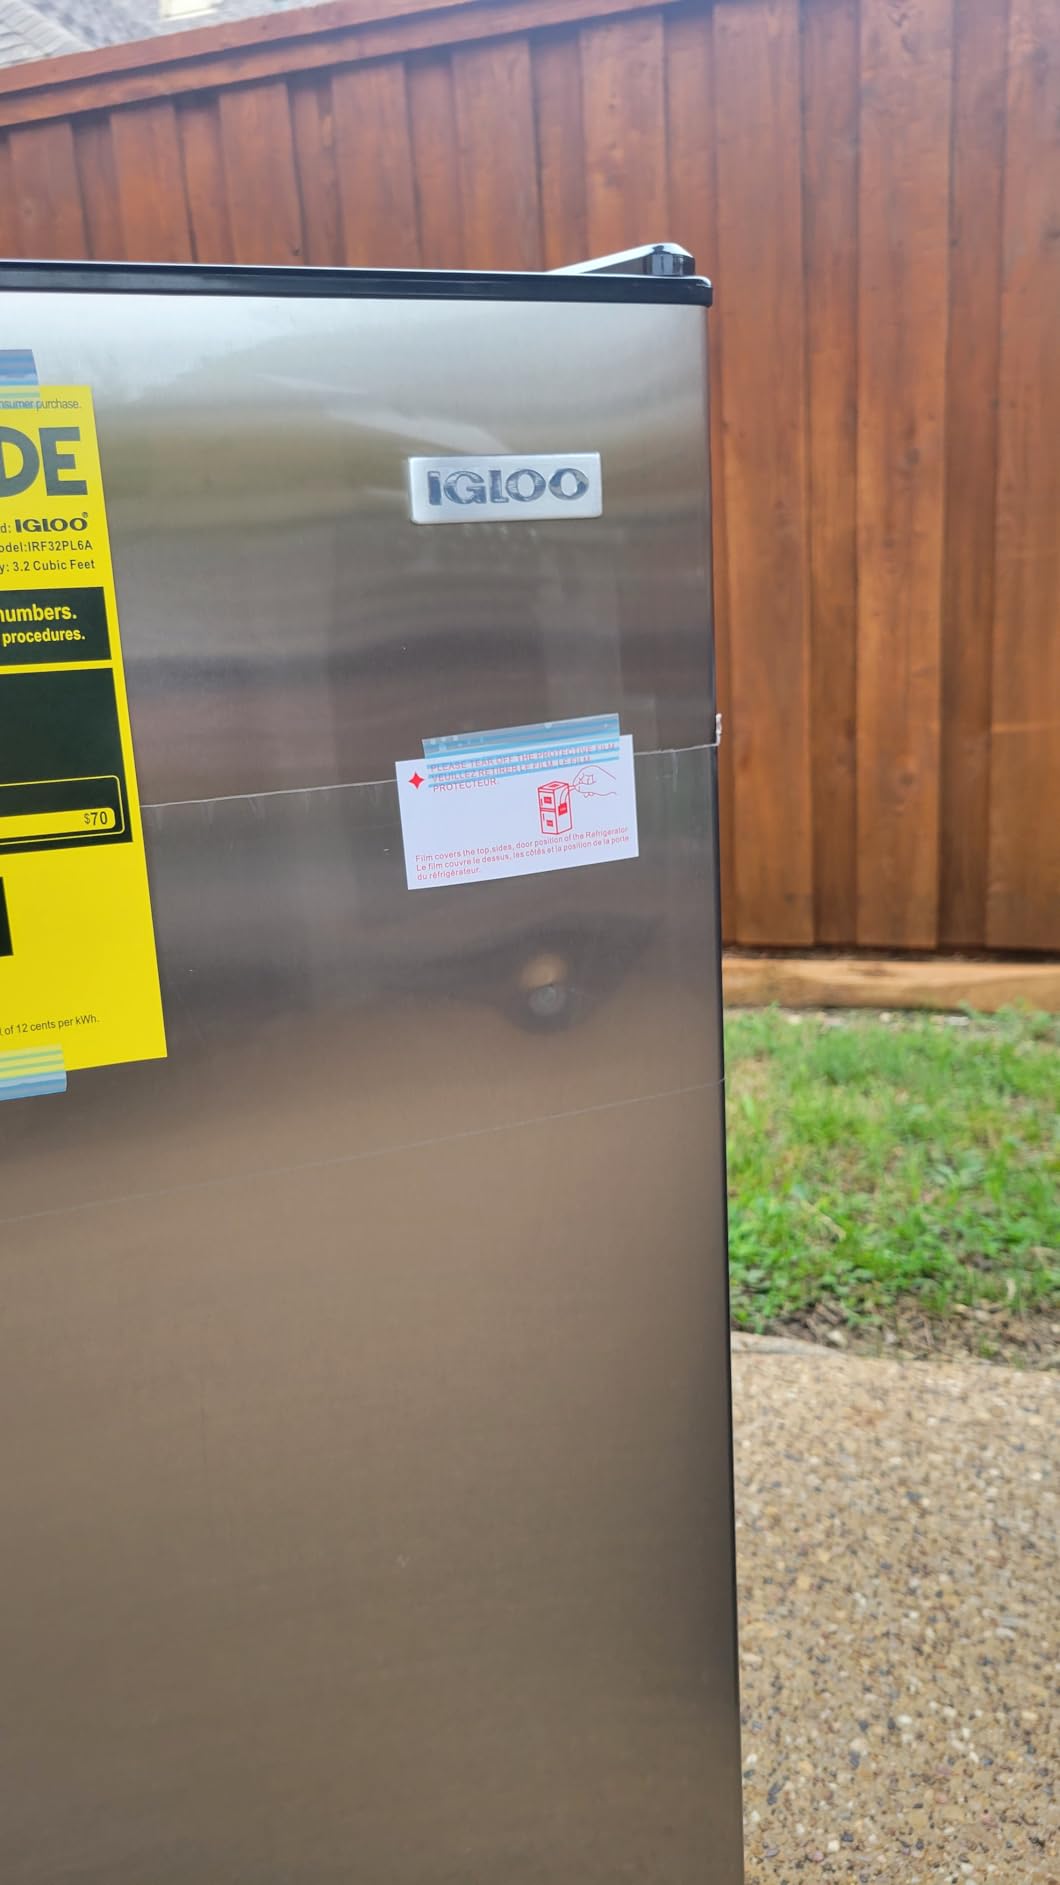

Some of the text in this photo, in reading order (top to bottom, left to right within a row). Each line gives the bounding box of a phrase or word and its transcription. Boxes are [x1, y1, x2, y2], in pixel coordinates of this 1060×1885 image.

[36, 398, 81, 412] purchase.
[0, 426, 88, 498] DE
[427, 467, 590, 506] IGLOO
[13, 561, 30, 571] 3.2
[33, 560, 67, 571] Cubic
[70, 559, 95, 569] Feet
[2, 628, 86, 647] procedures.
[431, 760, 467, 772] PLEASE
[471, 758, 494, 768] TEAR
[496, 756, 513, 765] OFF
[517, 752, 534, 761] THE
[537, 745, 592, 758] PROTECTIVE
[432, 770, 476, 782] VEUILLEZ
[478, 764, 517, 776] RETIRER
[520, 764, 529, 773] LE
[557, 758, 567, 767] LE
[433, 777, 496, 792] PROTECTEUR
[84, 811, 108, 826] $70
[416, 864, 427, 872] Le
[428, 862, 443, 870] film
[445, 859, 472, 868] couvre
[472, 857, 481, 865] le
[481, 853, 512, 864] dessus,
[525, 847, 545, 857] côtés
[546, 846, 554, 854] et
[563, 840, 592, 852] position
[592, 838, 601, 846] de
[603, 837, 610, 845] la
[611, 835, 629, 845] porte
[435, 850, 461, 860] covers
[462, 848, 475, 857] the
[516, 841, 533, 850] door
[535, 835, 562, 847] position
[564, 834, 572, 842] of
[572, 832, 584, 841] the
[417, 872, 428, 880] du
[5, 1024, 14, 1035] of
[17, 1023, 28, 1033] 12
[30, 1020, 56, 1032] cents
[58, 1018, 73, 1030] per
